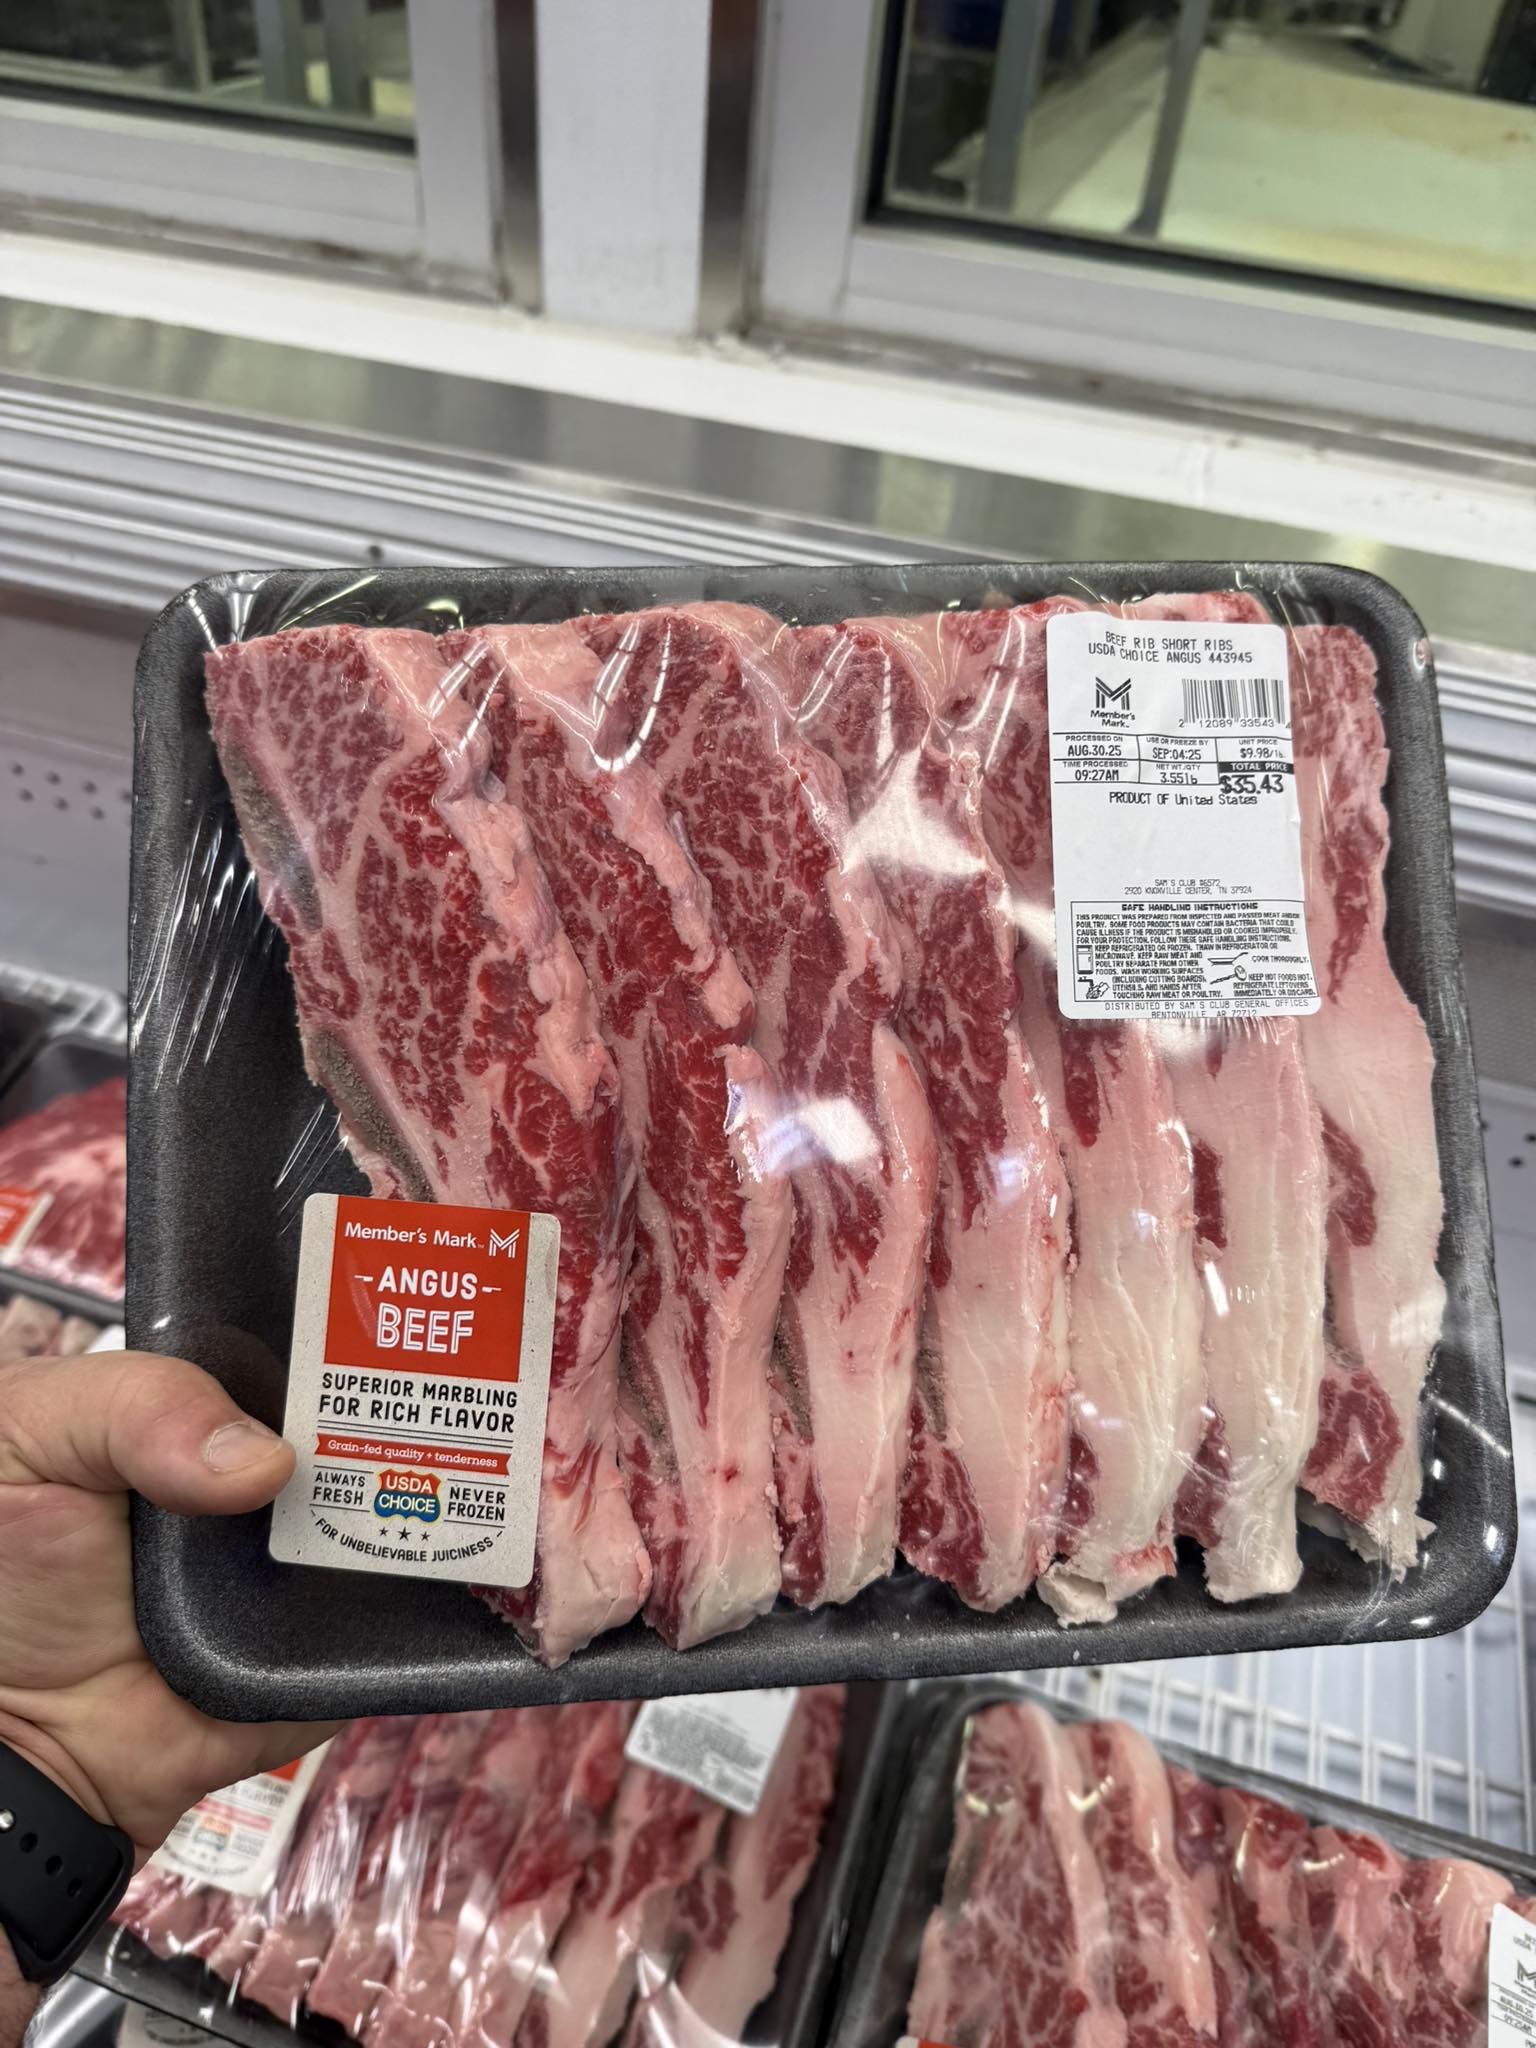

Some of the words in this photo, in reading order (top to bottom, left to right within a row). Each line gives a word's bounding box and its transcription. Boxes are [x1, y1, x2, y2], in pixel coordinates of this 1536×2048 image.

[1105, 631, 1127, 647] BEEF
[1133, 637, 1155, 650] RIB
[1162, 638, 1197, 651] SHORT
[1204, 639, 1233, 651] RIBS
[1088, 642, 1116, 656] USDA
[1120, 648, 1159, 662] CHOICE
[1166, 652, 1201, 664] ANGUS
[1208, 652, 1253, 663] 443945
[1090, 709, 1135, 721] Member's
[1178, 718, 1185, 728] 2
[1200, 719, 1233, 728] 12089
[1239, 719, 1275, 728] 33543
[1067, 744, 1122, 757] AUG.30.25
[1063, 760, 1081, 768] TIME
[1082, 760, 1128, 768] PROCESSED
[1231, 762, 1260, 771] TOTAL
[1264, 762, 1288, 772] PRICE
[1074, 769, 1120, 781] 09:27AM
[1160, 771, 1198, 785] 3.55lb
[1219, 773, 1284, 795] $35.43
[1109, 791, 1152, 805] PRODUCT
[1157, 792, 1169, 805] OF
[1175, 792, 1213, 805] United
[1218, 793, 1258, 805] States
[1179, 878, 1196, 887] CLUB
[1145, 886, 1181, 895] KNOXVILLE
[1219, 886, 1228, 894] TN
[1121, 903, 1145, 911] SAFE
[1148, 903, 1191, 911] HANDLING
[1194, 902, 1258, 912] INSTRUCTIONS
[1197, 920, 1224, 928] CONTAIN
[1145, 928, 1173, 936] PRODUCT
[1223, 927, 1232, 935] OR
[1076, 936, 1089, 944] FOR
[1090, 936, 1108, 944] YOUR
[1198, 935, 1214, 943] SAFE
[1215, 935, 1247, 943] HANDLING
[1094, 944, 1110, 952] KEEP
[1111, 944, 1156, 952] REFRIGERATED
[1195, 943, 1214, 951] THAW
[1190, 951, 1203, 959] AND
[1251, 955, 1269, 963] COOK
[1178, 959, 1199, 967] OTHER
[1171, 967, 1204, 975] SURFACES
[1148, 975, 1176, 983] CUTTING
[1248, 973, 1264, 981] KEEP
[1264, 973, 1277, 981] HOT
[1160, 983, 1180, 991] HANDS
[1233, 981, 1275, 989] REFRIGERATE
[1233, 989, 1277, 997] IMMEDIATELY
[1104, 1001, 1160, 1010] DISTRIBUTED
[1164, 1001, 1175, 1010] BY
[1209, 1001, 1230, 1009] CLUB
[1234, 1000, 1271, 1009] GENERAL
[1275, 999, 1309, 1008] OFFICES
[1216, 1010, 1227, 1018] AR
[1232, 1009, 1257, 1018] 72712
[344, 1221, 428, 1244] Member's
[377, 1265, 478, 1300] ANGUS
[376, 1302, 475, 1354] BEEF
[322, 1372, 415, 1398] SUPERIOR
[422, 1381, 518, 1408] MARBLING
[319, 1393, 361, 1417] FOR
[370, 1399, 421, 1424] RICH
[430, 1405, 516, 1433] FLAVOR
[328, 1438, 382, 1456] Grain-fed
[384, 1444, 425, 1462] quality
[434, 1450, 499, 1468] tenderness
[314, 1470, 367, 1488] ALWAYS
[385, 1474, 434, 1495] USDA
[312, 1486, 365, 1506] FRESH
[449, 1486, 507, 1505] NEVER
[377, 1493, 437, 1514] CHOICE
[447, 1502, 506, 1522] FROZEN
[315, 1517, 339, 1541] FOR
[340, 1535, 428, 1562] UNBELIEVABLE
[431, 1536, 494, 1562] JUICINESS
